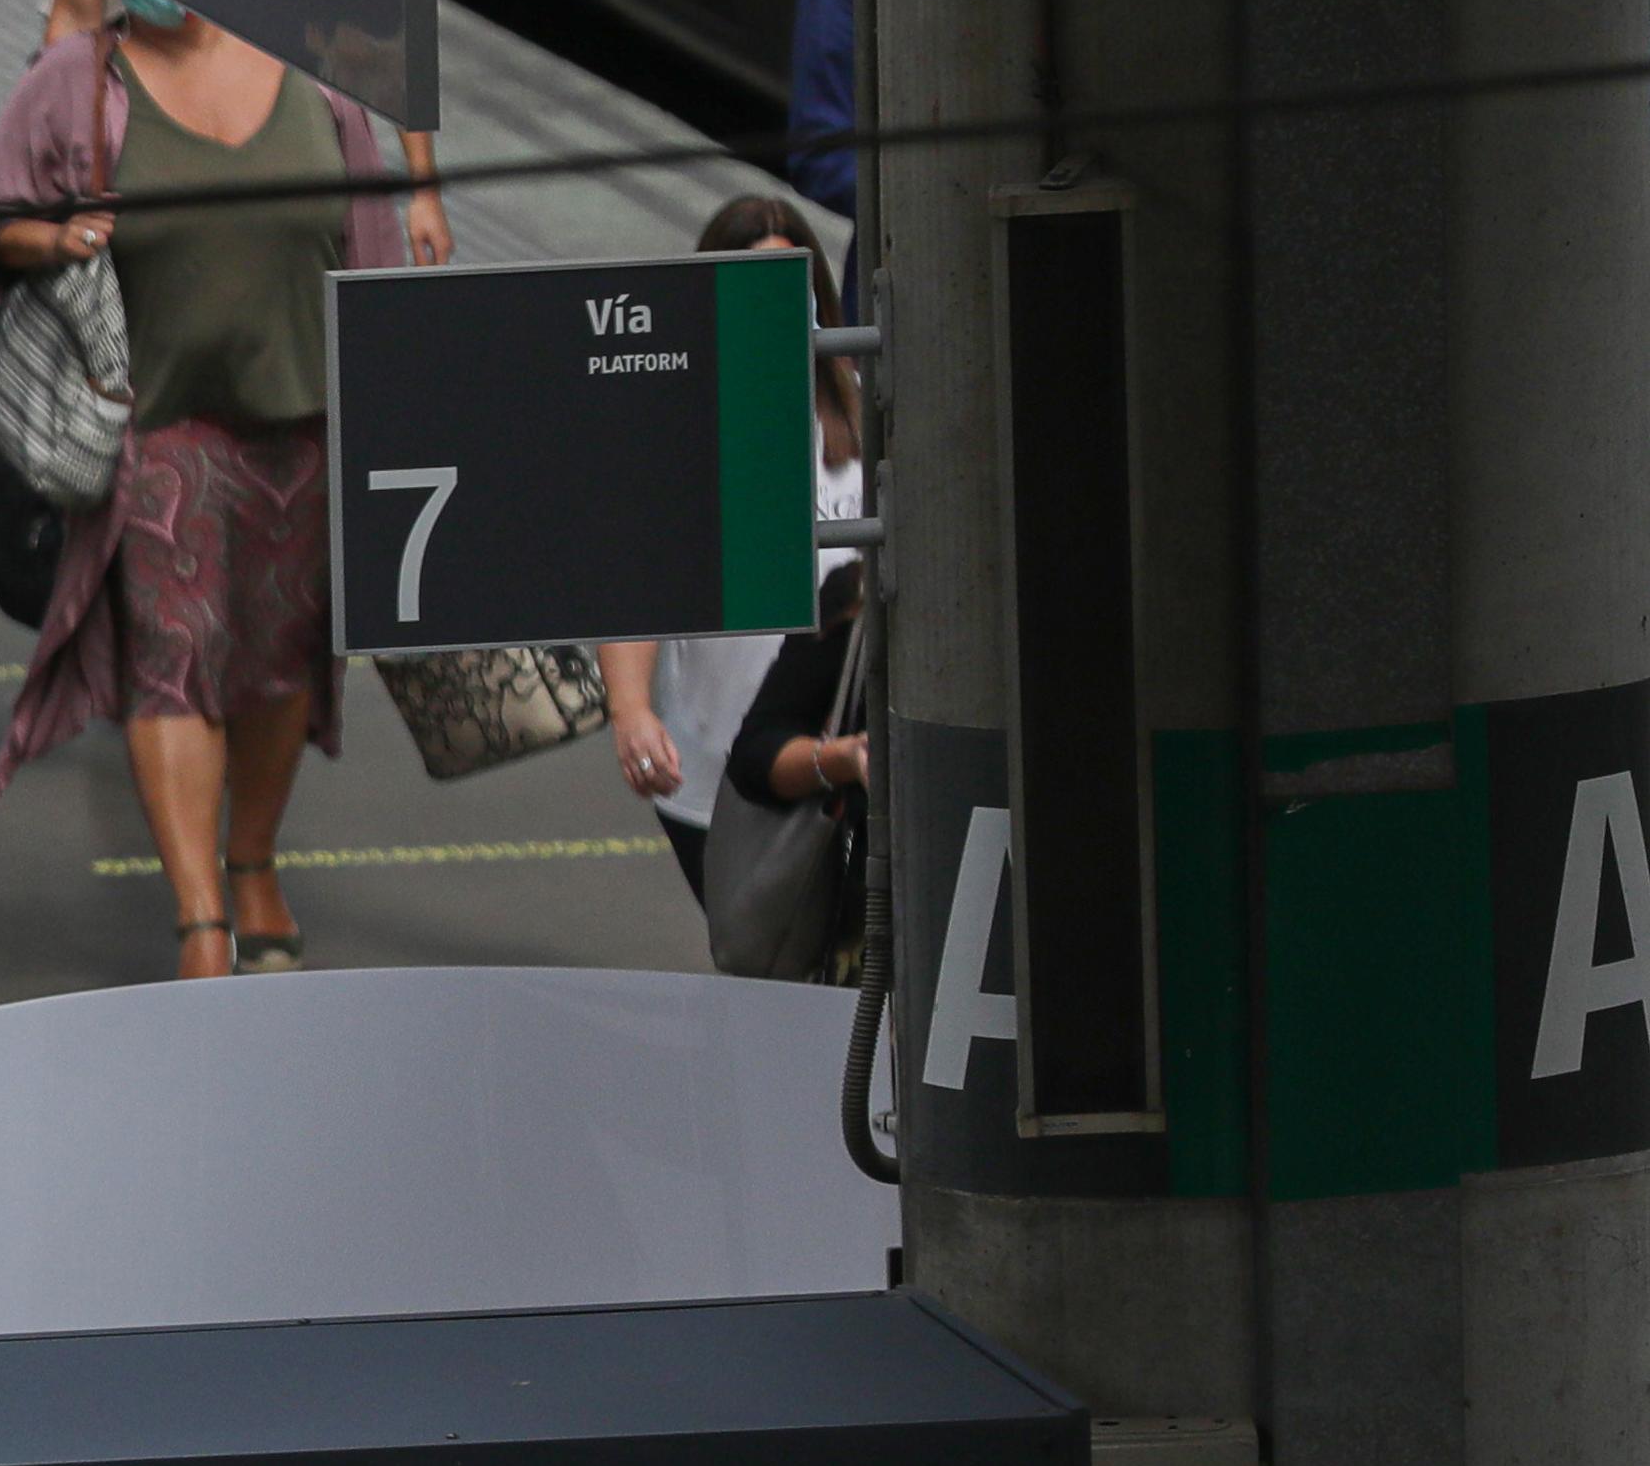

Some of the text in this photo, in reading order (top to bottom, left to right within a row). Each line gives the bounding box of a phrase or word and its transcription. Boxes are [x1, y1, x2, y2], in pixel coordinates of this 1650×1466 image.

[585, 292, 653, 337] Vía
[587, 350, 689, 376] PLATFORM
[367, 465, 459, 623] 7
[1531, 771, 1650, 1080] A
